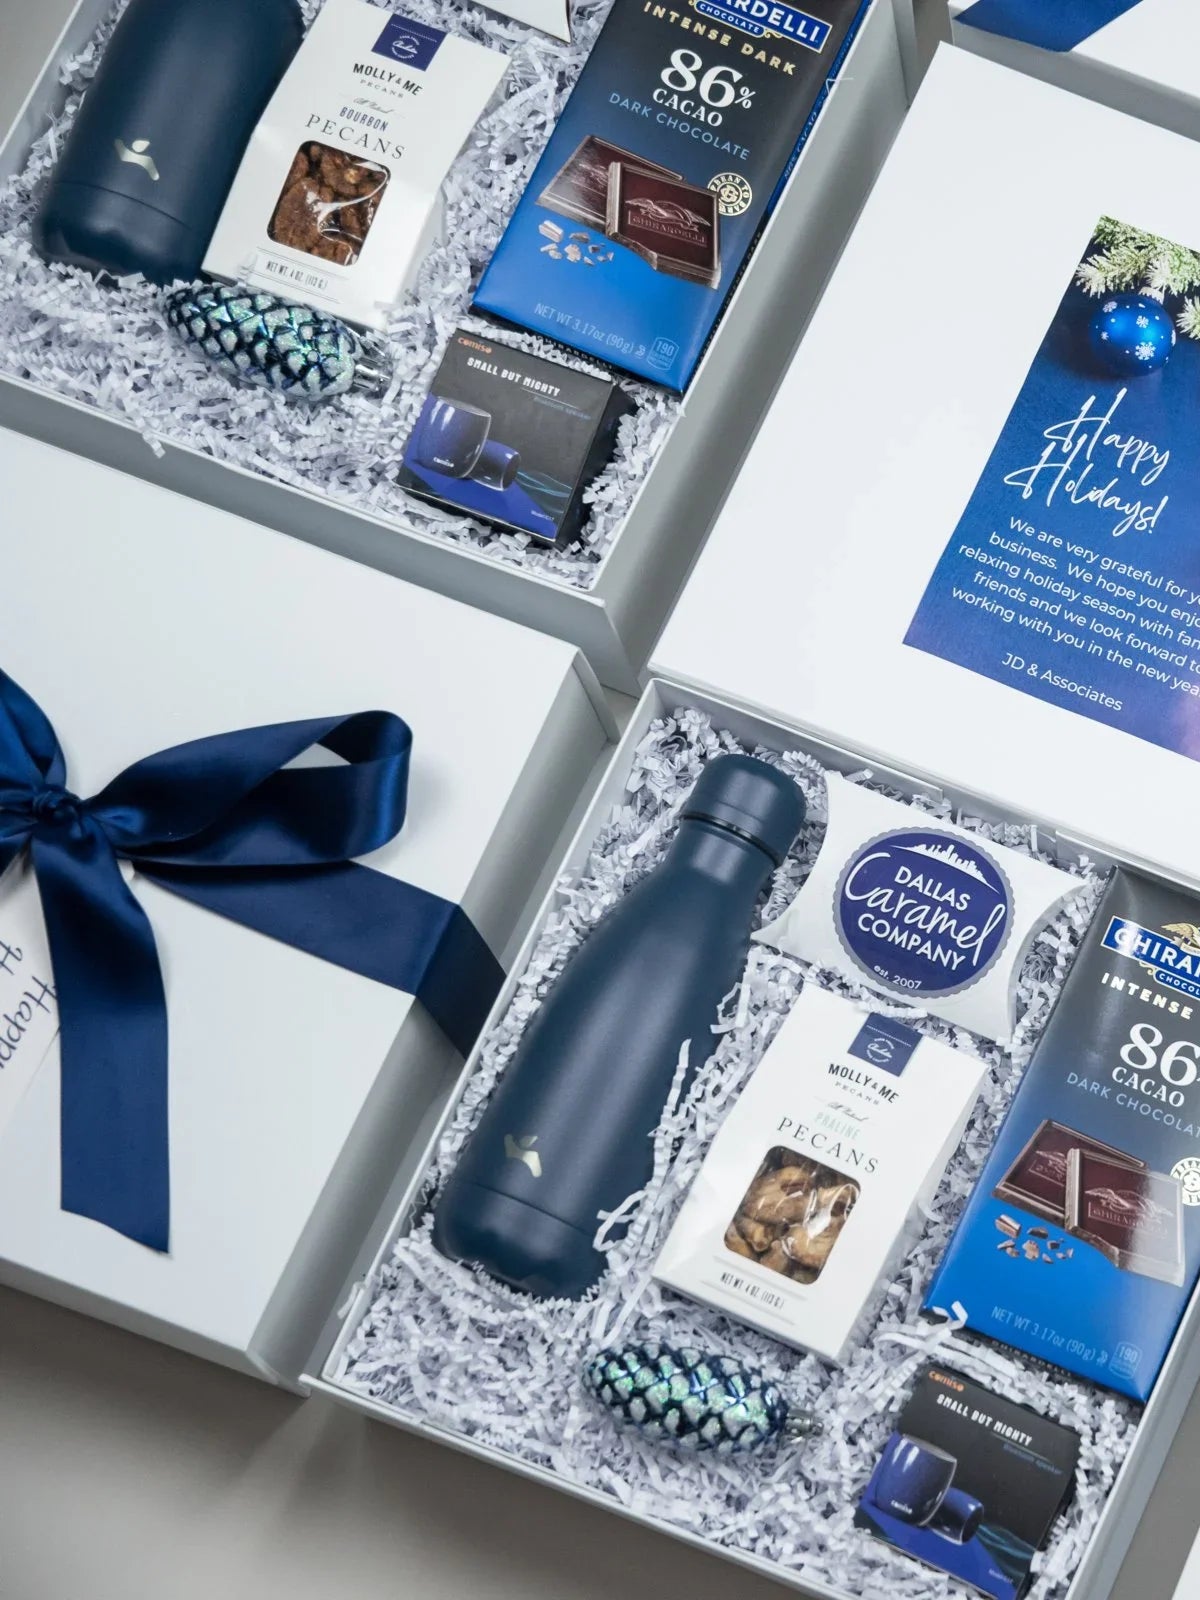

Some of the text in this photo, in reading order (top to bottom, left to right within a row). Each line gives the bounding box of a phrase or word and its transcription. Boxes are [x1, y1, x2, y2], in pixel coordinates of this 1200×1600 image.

[643, 2, 797, 76] INTENSE DARK
[700, 3, 760, 34] CHOCOLATE
[726, 0, 820, 42] RDELLI
[352, 63, 396, 83] MOLLY
[403, 80, 424, 97] ME
[661, 49, 756, 109] 86%
[339, 106, 389, 132] BOURBON
[609, 92, 750, 160] DARK CHOCOLATE
[652, 88, 723, 127] CACAO
[305, 113, 405, 160] PECANS
[534, 302, 554, 318] NET
[556, 311, 573, 326] WT
[572, 319, 605, 341] 3.17oz
[606, 333, 635, 354] (90g)
[655, 340, 674, 356] 190
[467, 357, 561, 397] SMALL BUT MIGHTY
[1043, 387, 1169, 487] Happy
[1003, 433, 1169, 537] Holidays!
[989, 531, 1058, 570] business.
[1067, 563, 1093, 583] We
[1096, 573, 1136, 602] hope
[1136, 593, 1169, 614] you
[1009, 516, 1034, 537] We
[1037, 530, 1063, 548] are
[1065, 541, 1099, 564] very
[1101, 555, 1164, 589] grateful
[1165, 579, 1188, 598] for
[958, 543, 1021, 578] relaxing
[1023, 569, 1081, 602] holiday
[1082, 593, 1136, 623] season
[1140, 615, 1174, 640] with
[952, 587, 1016, 623] working
[1018, 614, 1053, 636] with
[1053, 628, 1085, 649] you
[1088, 639, 1103, 656] in
[1106, 648, 1133, 668] the
[1136, 662, 1170, 683] new
[973, 570, 1027, 602] friends
[1029, 594, 1061, 616] and
[1064, 610, 1087, 627] we
[1089, 618, 1122, 642] look
[1125, 632, 1193, 667] forward
[1002, 652, 1123, 711] JD & Associates
[845, 852, 1006, 967] Caramel
[894, 866, 971, 911] DALLAS
[857, 913, 965, 971] COMPANY
[874, 965, 921, 990] est. 2007
[1101, 972, 1193, 1020] INTENSE
[0, 976, 57, 1069] Happ
[828, 1063, 873, 1089] MOLLY
[878, 1085, 899, 1104] ME
[1066, 1071, 1112, 1100] DARK
[1112, 1066, 1185, 1108] CACAO
[777, 1116, 879, 1173] PECANS
[814, 1111, 861, 1140] PRALINE
[991, 1305, 1013, 1324] NET
[1014, 1315, 1031, 1331] WT
[1031, 1322, 1065, 1348] 3.17oz
[1066, 1338, 1096, 1361] (90g)
[1118, 1345, 1138, 1362] 190
[936, 1393, 1033, 1446] SMALL BUT MIGHTY
